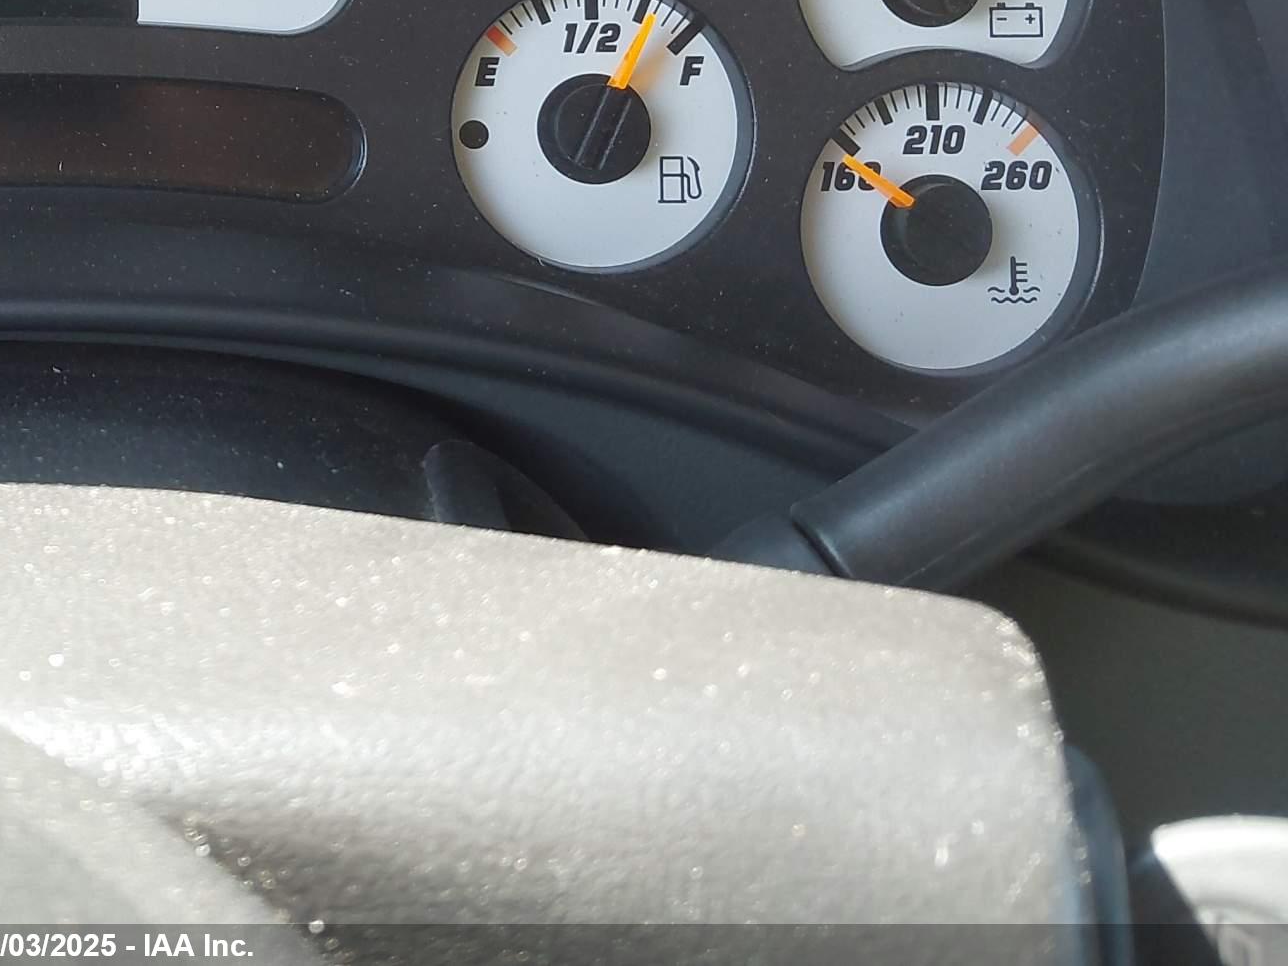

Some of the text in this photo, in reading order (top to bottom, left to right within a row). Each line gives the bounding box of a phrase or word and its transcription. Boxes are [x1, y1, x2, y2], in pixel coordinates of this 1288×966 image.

[564, 22, 620, 53] 1/2
[473, 56, 499, 86] E
[680, 56, 704, 85] F
[903, 125, 965, 154] 210
[981, 161, 1052, 190] 260
